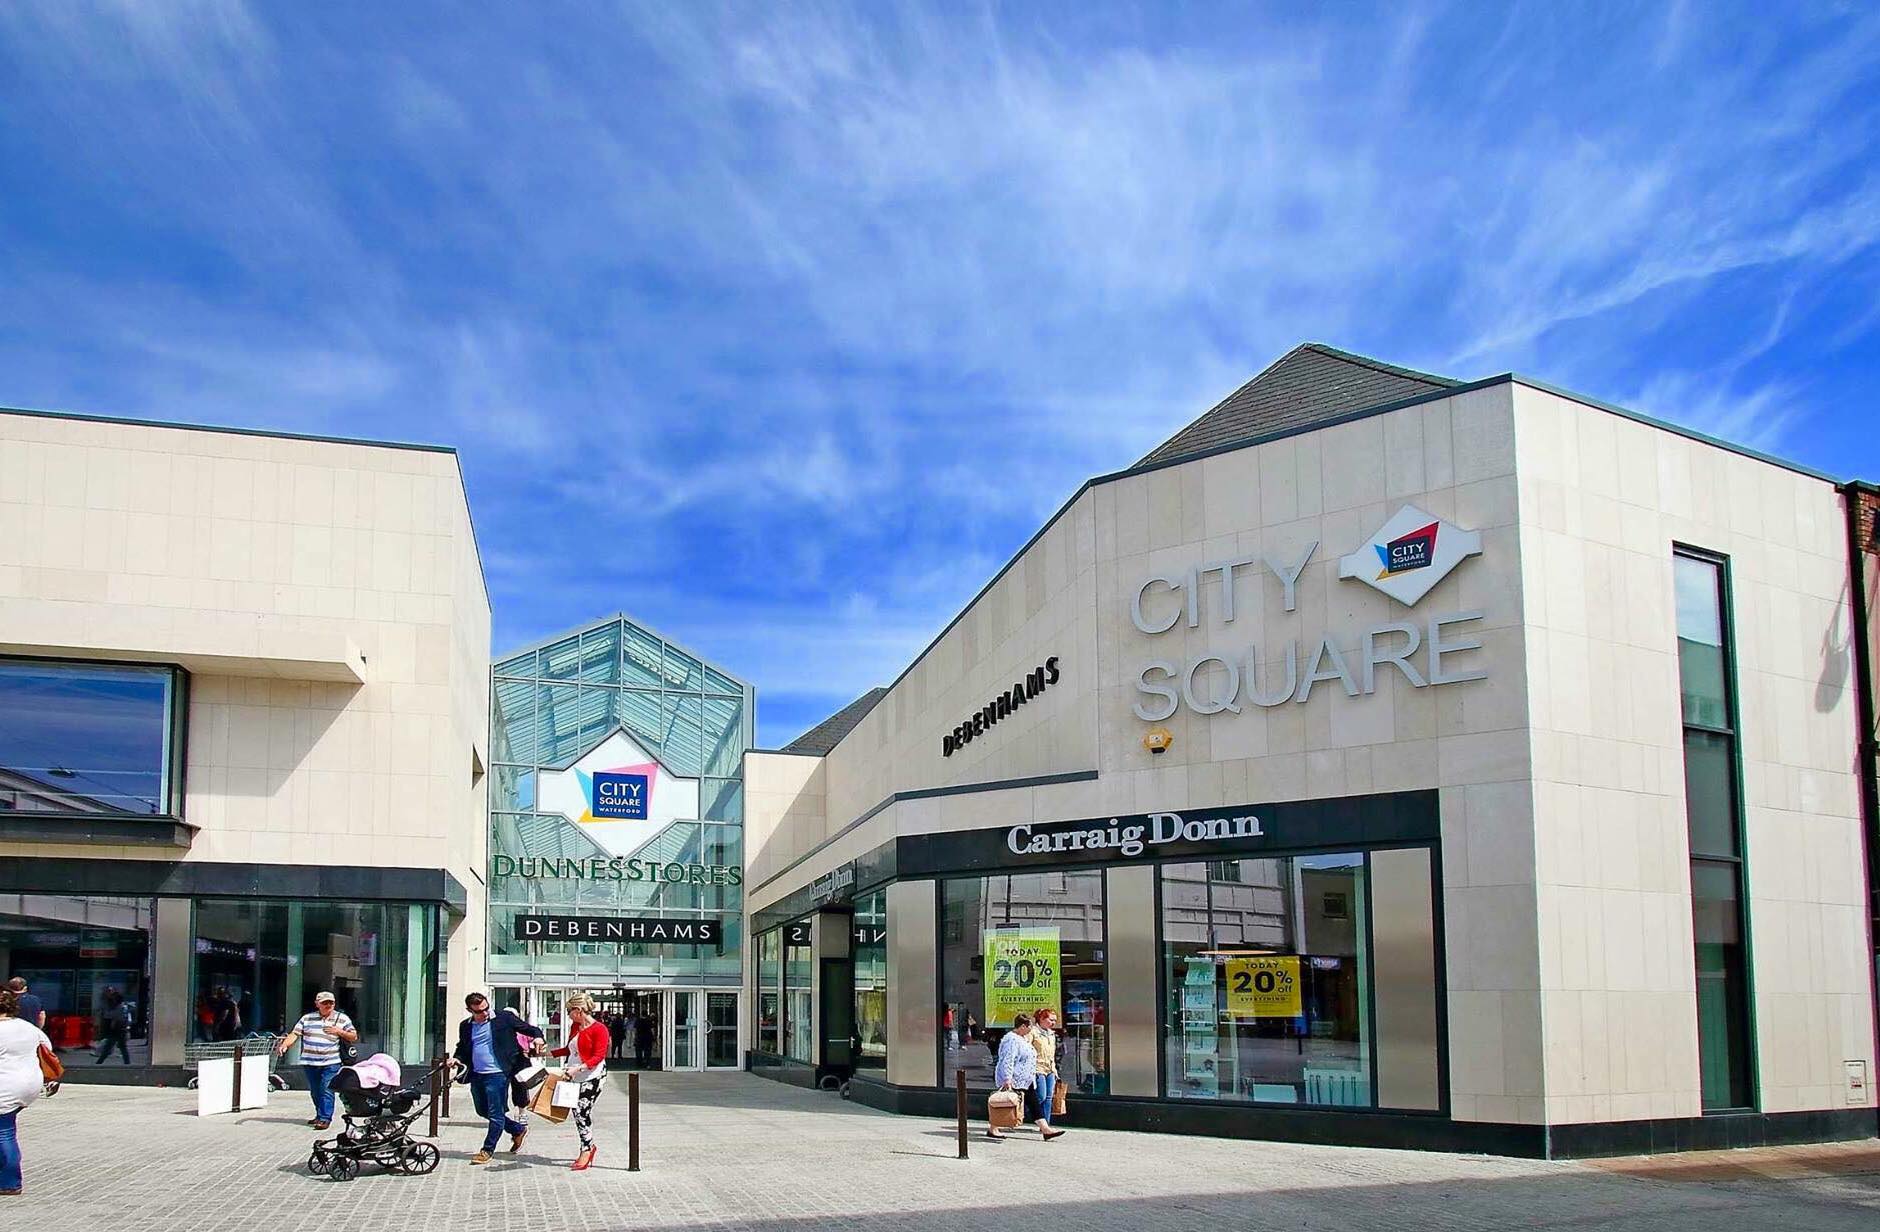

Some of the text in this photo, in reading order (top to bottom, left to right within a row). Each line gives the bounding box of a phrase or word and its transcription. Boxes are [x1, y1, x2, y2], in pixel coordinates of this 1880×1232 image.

[1392, 542, 1425, 557] CITY
[1392, 552, 1425, 564] SQUARE
[1131, 540, 1319, 634] CITY
[1132, 609, 1488, 722] SQUARE
[942, 656, 1060, 757] DEBENHAMS
[599, 782, 641, 797] CITY
[599, 797, 641, 807] SQUARE
[1007, 812, 1264, 856] Carraig Donn
[525, 920, 711, 939] DEBENHAMS
[1005, 948, 1039, 956] TODAY
[993, 959, 1053, 989] 20% off
[1233, 970, 1293, 993] 20% off
